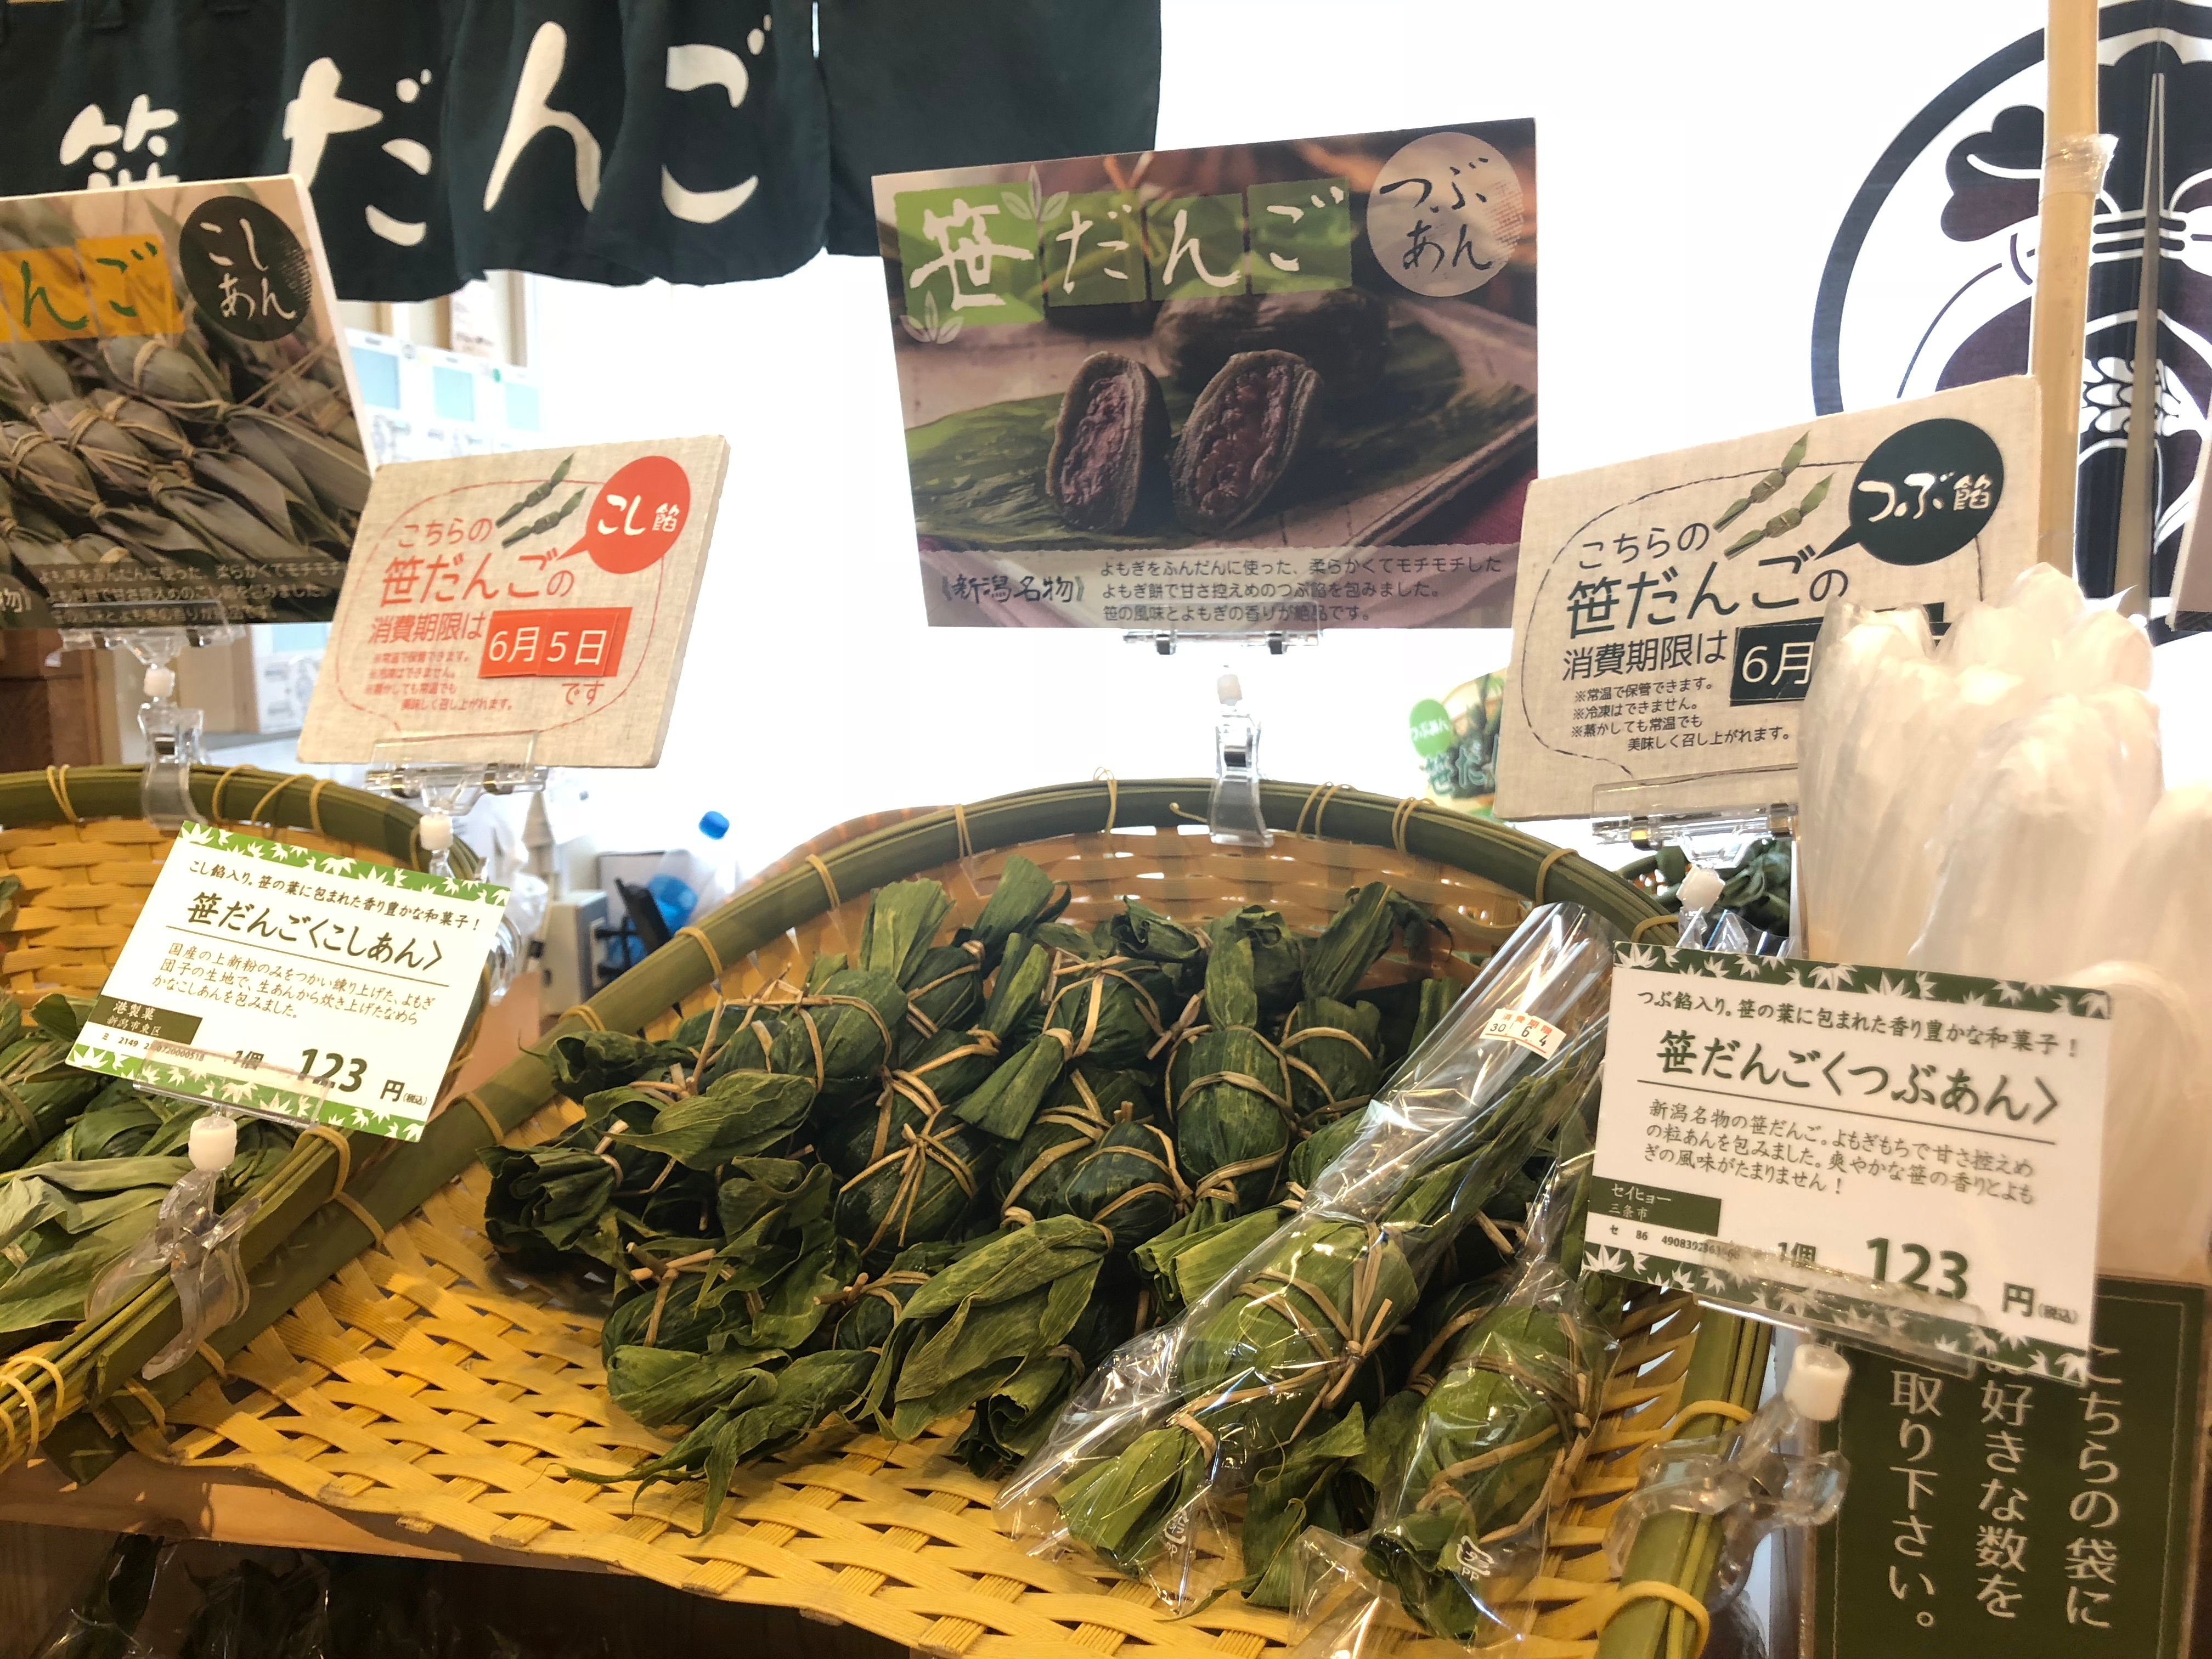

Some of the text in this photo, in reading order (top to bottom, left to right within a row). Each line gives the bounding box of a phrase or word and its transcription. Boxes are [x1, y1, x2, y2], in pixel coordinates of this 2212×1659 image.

[1380, 157, 1488, 213] つぶ
[200, 218, 268, 272] こし
[909, 186, 1344, 311] 笹だんご
[1403, 219, 1492, 273] あん
[219, 273, 296, 320] あん
[597, 494, 680, 536] こし餡
[1858, 472, 1990, 522] つぶ餡
[399, 518, 493, 548] こちらの
[1578, 522, 1709, 569] こちらの
[381, 548, 574, 607] 笹だんごの
[1567, 544, 1849, 640] 笹だんごの
[368, 612, 487, 644] 消費期限は
[1562, 631, 1728, 681] 消費期限は
[561, 681, 605, 706] です
[1628, 726, 1789, 752] 美味しく召し上がれます。
[107, 1015, 162, 1036] 新潟市東区
[112, 1001, 156, 1020] 港製菓
[1502, 1013, 1553, 1036] 消費期限
[118, 1036, 139, 1047] 2149
[233, 1049, 264, 1070] 1個
[297, 1048, 368, 1092] 123
[1609, 1203, 1648, 1221] 三条市
[1611, 1183, 1672, 1204] セイヒョー
[1635, 1229, 1648, 1240] 86
[1866, 1237, 1968, 1300] 123
[1889, 1370, 1944, 1628] 取り下さい。
[1976, 1364, 2034, 1618] 好きな数を
